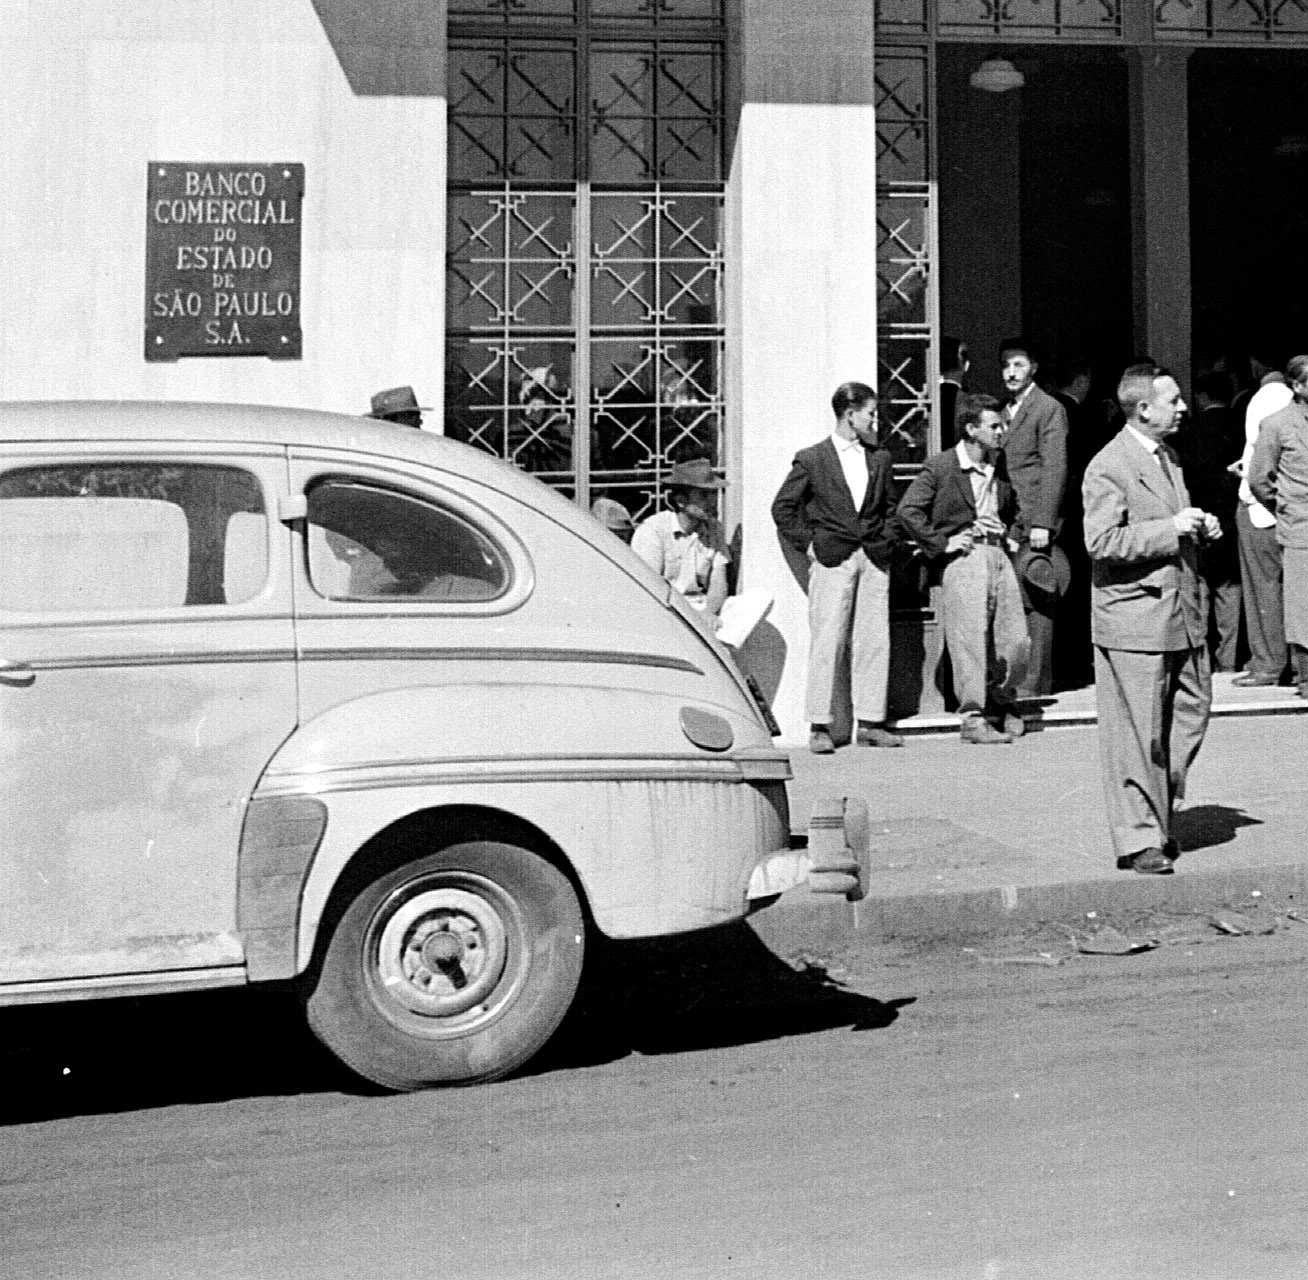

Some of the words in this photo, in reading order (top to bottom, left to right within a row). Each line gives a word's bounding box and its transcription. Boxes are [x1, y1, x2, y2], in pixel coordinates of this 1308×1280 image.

[185, 171, 266, 196] BANCO
[154, 199, 295, 224] COMERCIAL
[213, 227, 237, 242] DO
[176, 246, 273, 270] ESTADO
[212, 273, 235, 288] DE
[153, 288, 202, 317] SÃO
[213, 291, 292, 317] PAULO
[205, 320, 251, 345] S.A.
